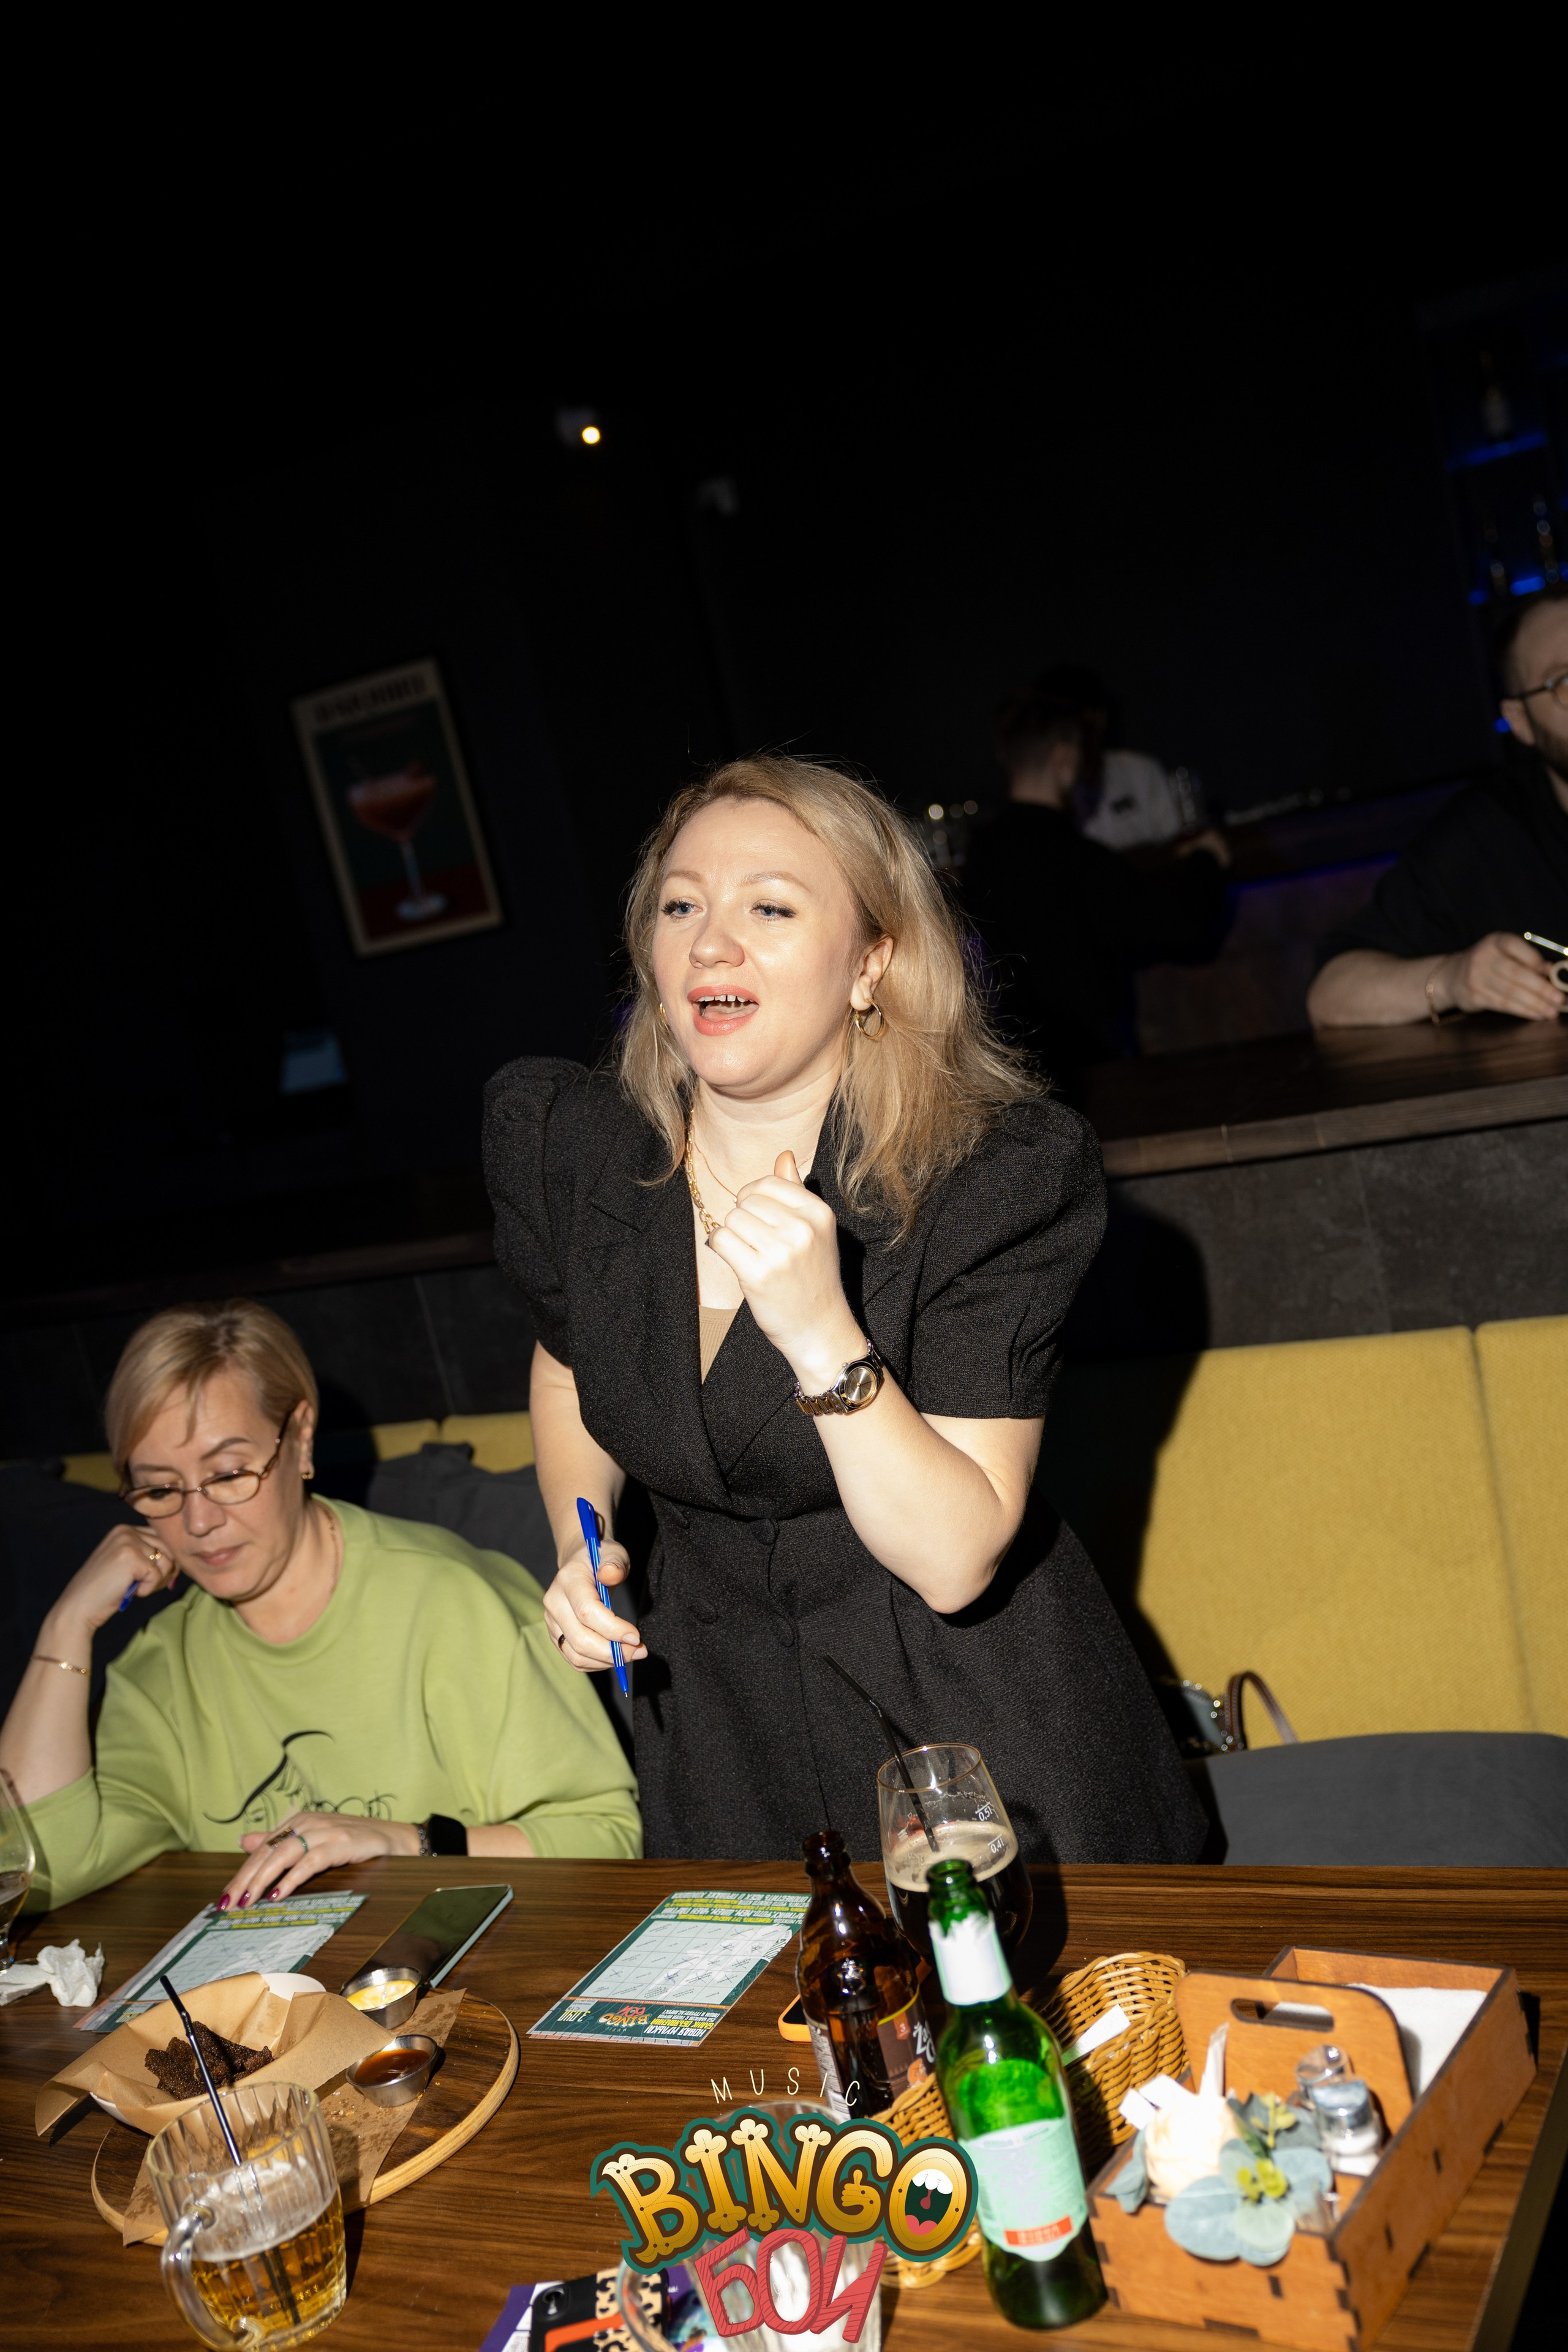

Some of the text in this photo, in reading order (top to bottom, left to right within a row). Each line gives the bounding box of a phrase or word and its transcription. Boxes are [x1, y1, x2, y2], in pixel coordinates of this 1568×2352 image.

[597, 2011, 650, 2027] BINGO
[649, 2018, 693, 2027] ОБЪЯВЛЕНИЙ
[643, 2024, 707, 2037] НОВАЯ МУЛЬКА!
